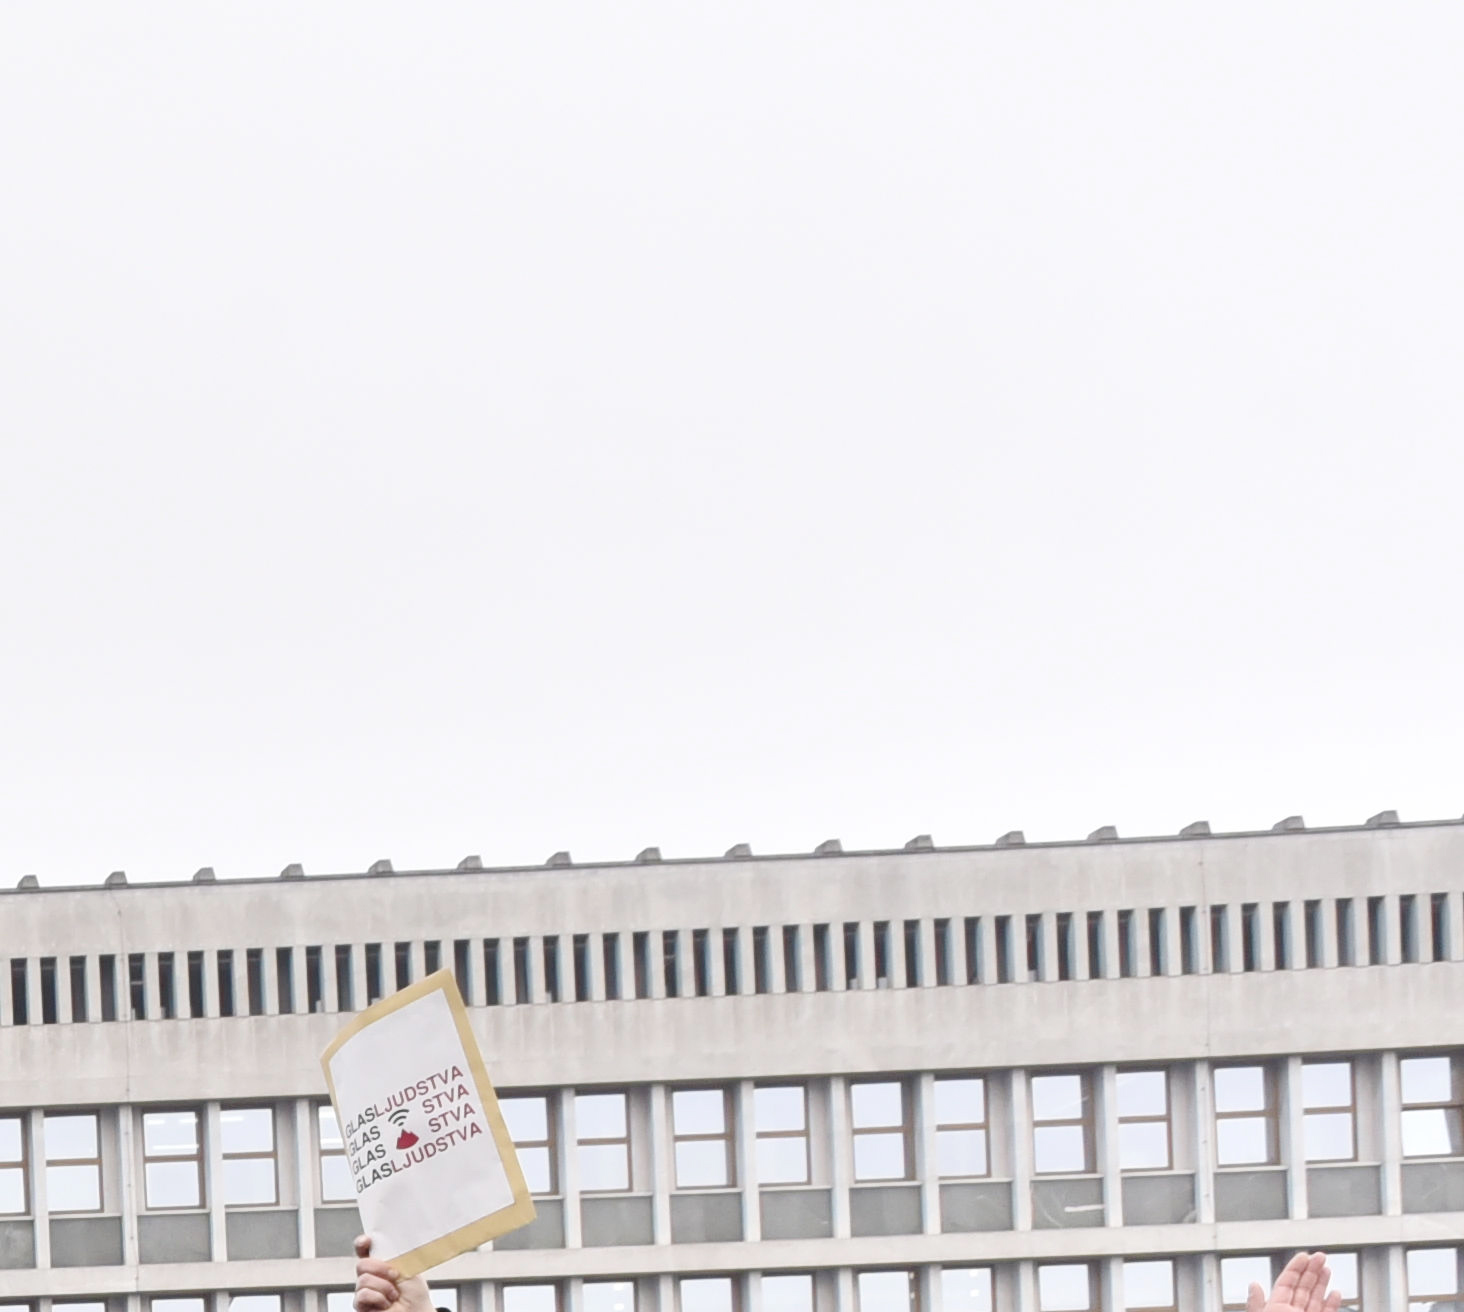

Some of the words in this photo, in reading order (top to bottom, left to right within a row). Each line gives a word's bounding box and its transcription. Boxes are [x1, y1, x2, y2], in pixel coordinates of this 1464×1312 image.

[348, 1125, 381, 1156] GLAS
[422, 1083, 469, 1113] STVA
[352, 1144, 386, 1174] GLAS
[428, 1103, 475, 1133] STVA
